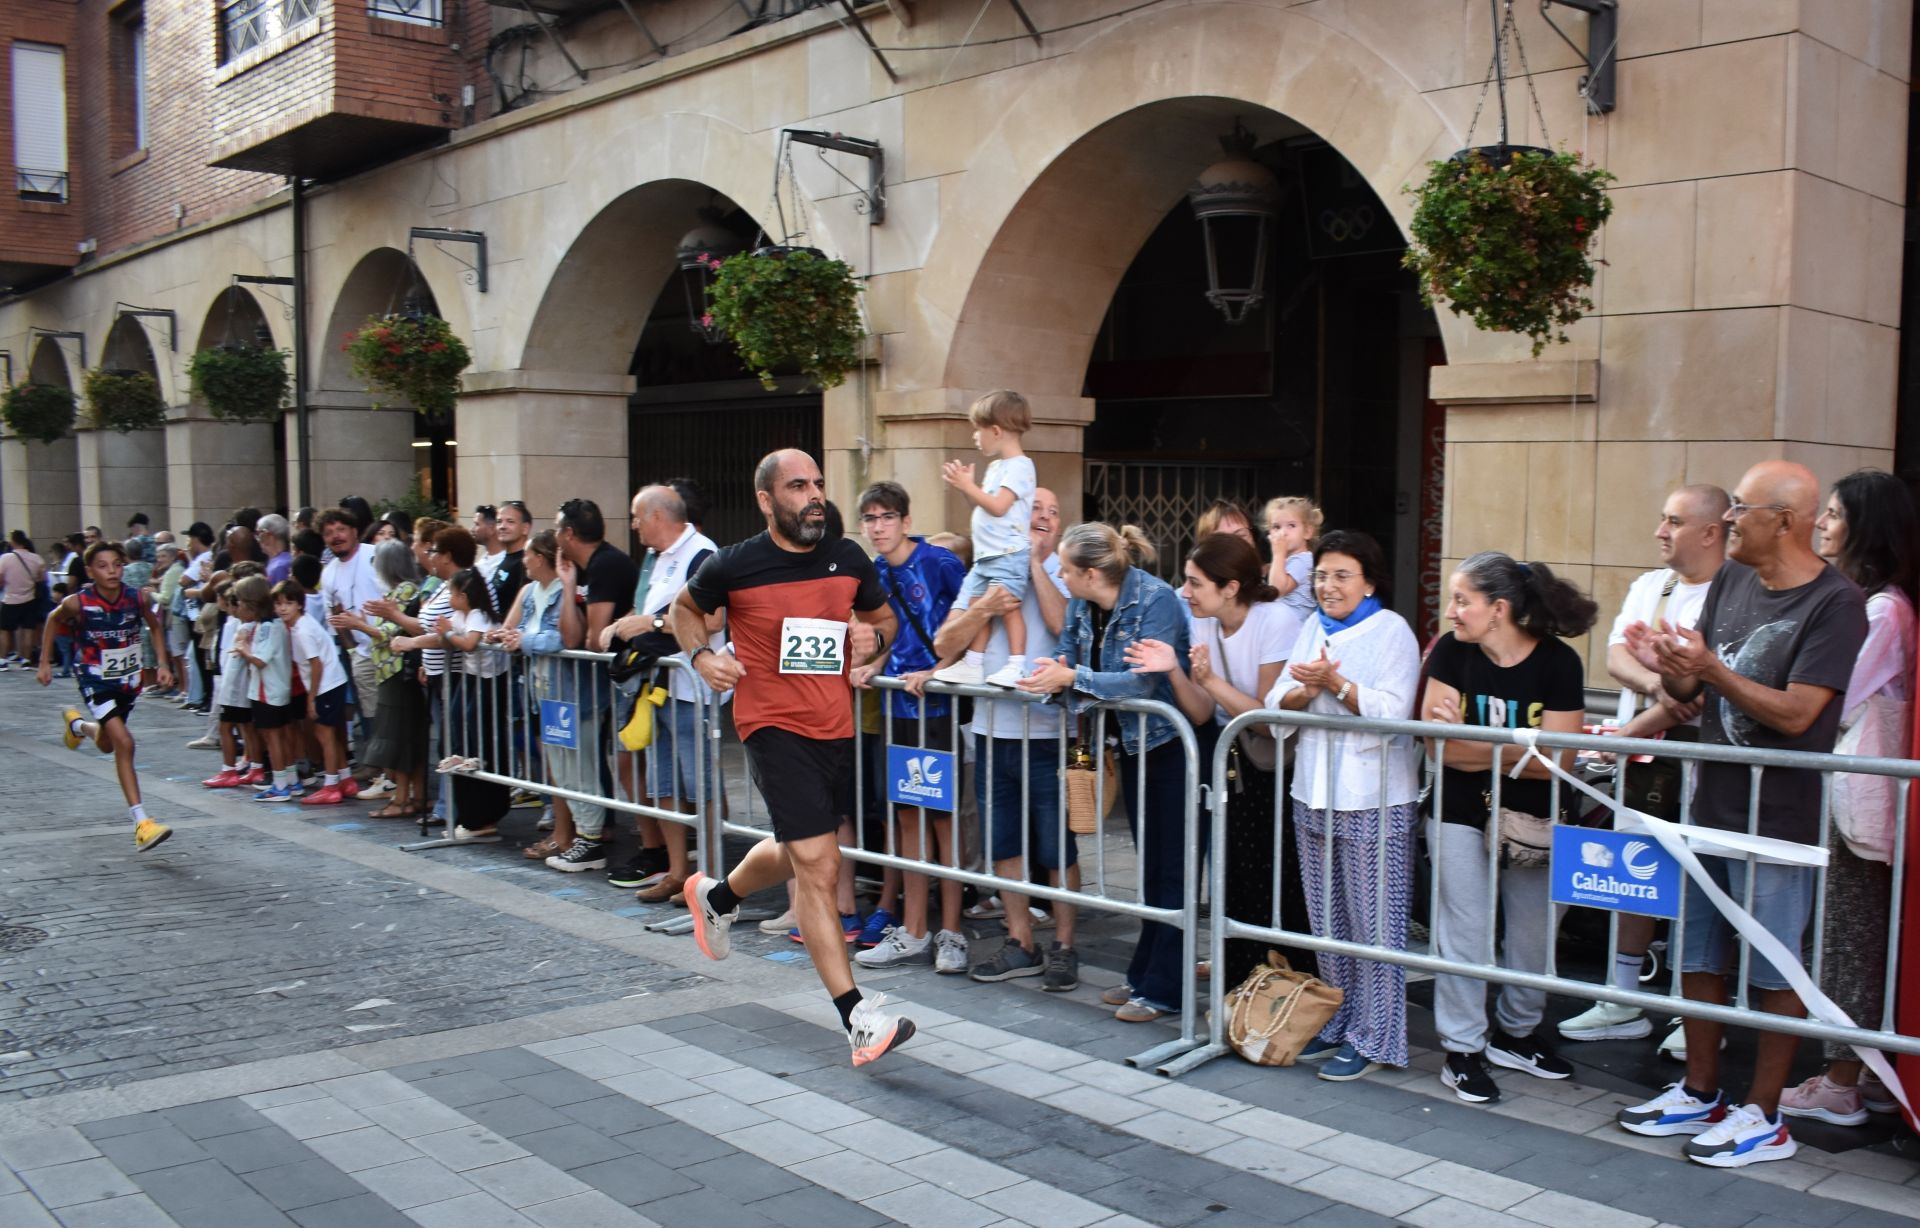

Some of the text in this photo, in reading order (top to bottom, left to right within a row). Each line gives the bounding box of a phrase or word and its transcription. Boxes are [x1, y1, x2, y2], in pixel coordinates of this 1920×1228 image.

[787, 635, 837, 658] 232
[107, 653, 137, 671] 215
[1571, 871, 1659, 900] Calahorra
